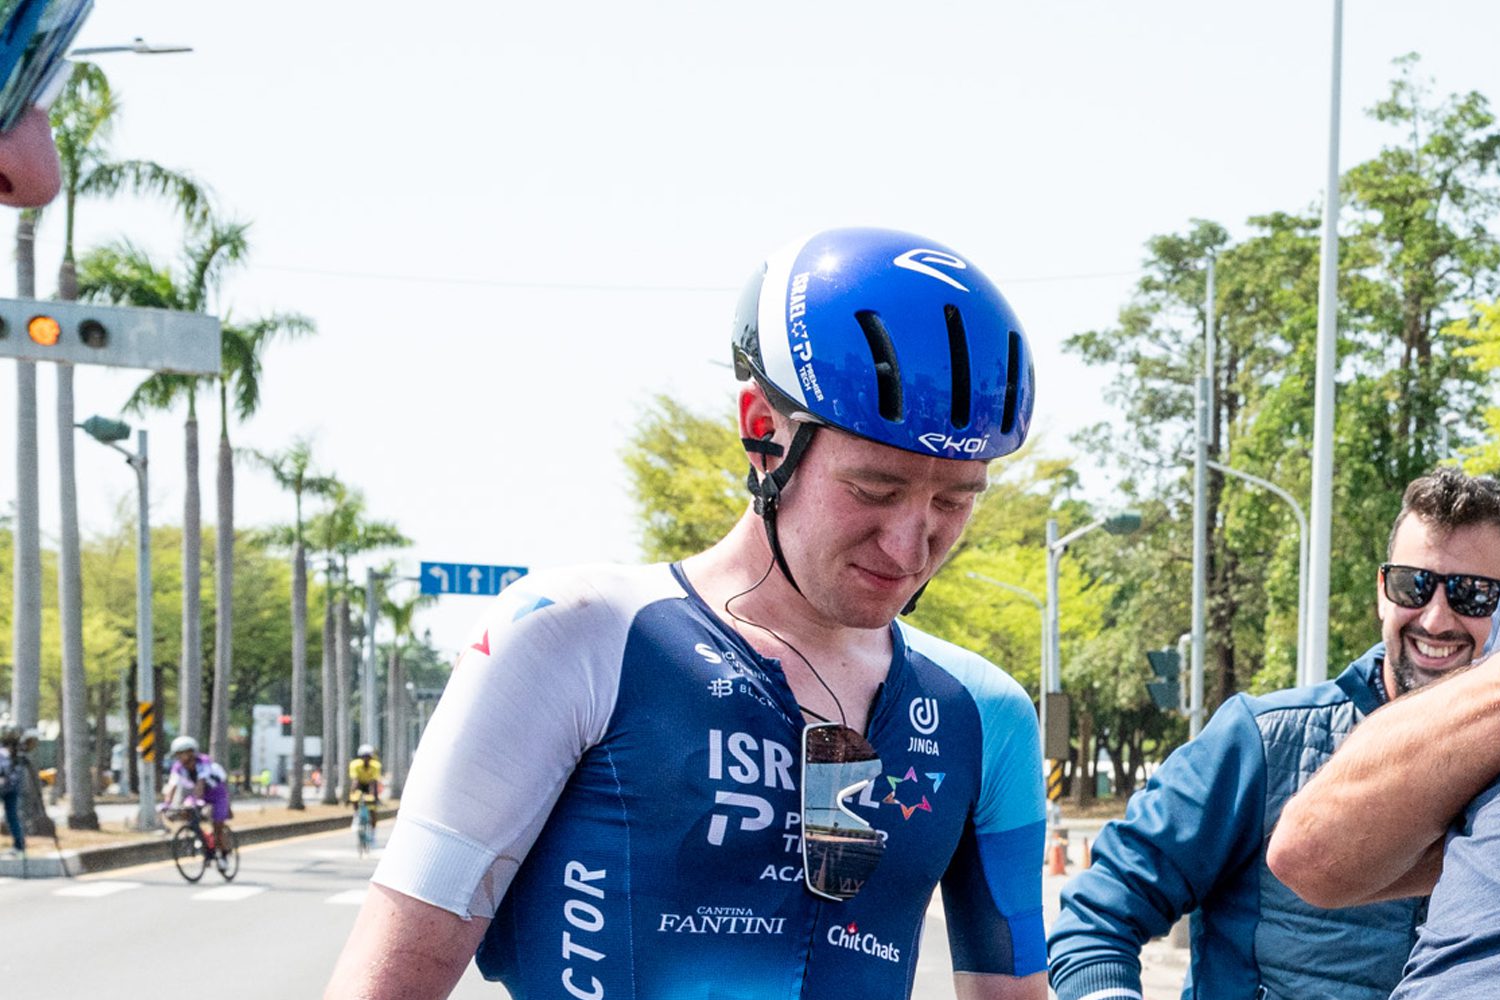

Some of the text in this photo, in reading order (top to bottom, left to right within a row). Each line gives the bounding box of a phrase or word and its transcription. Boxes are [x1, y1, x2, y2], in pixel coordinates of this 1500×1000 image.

[907, 737, 940, 756] JINGA
[708, 728, 880, 809] ISRL
[697, 906, 754, 916] CANTINA
[657, 914, 787, 934] FANTINI
